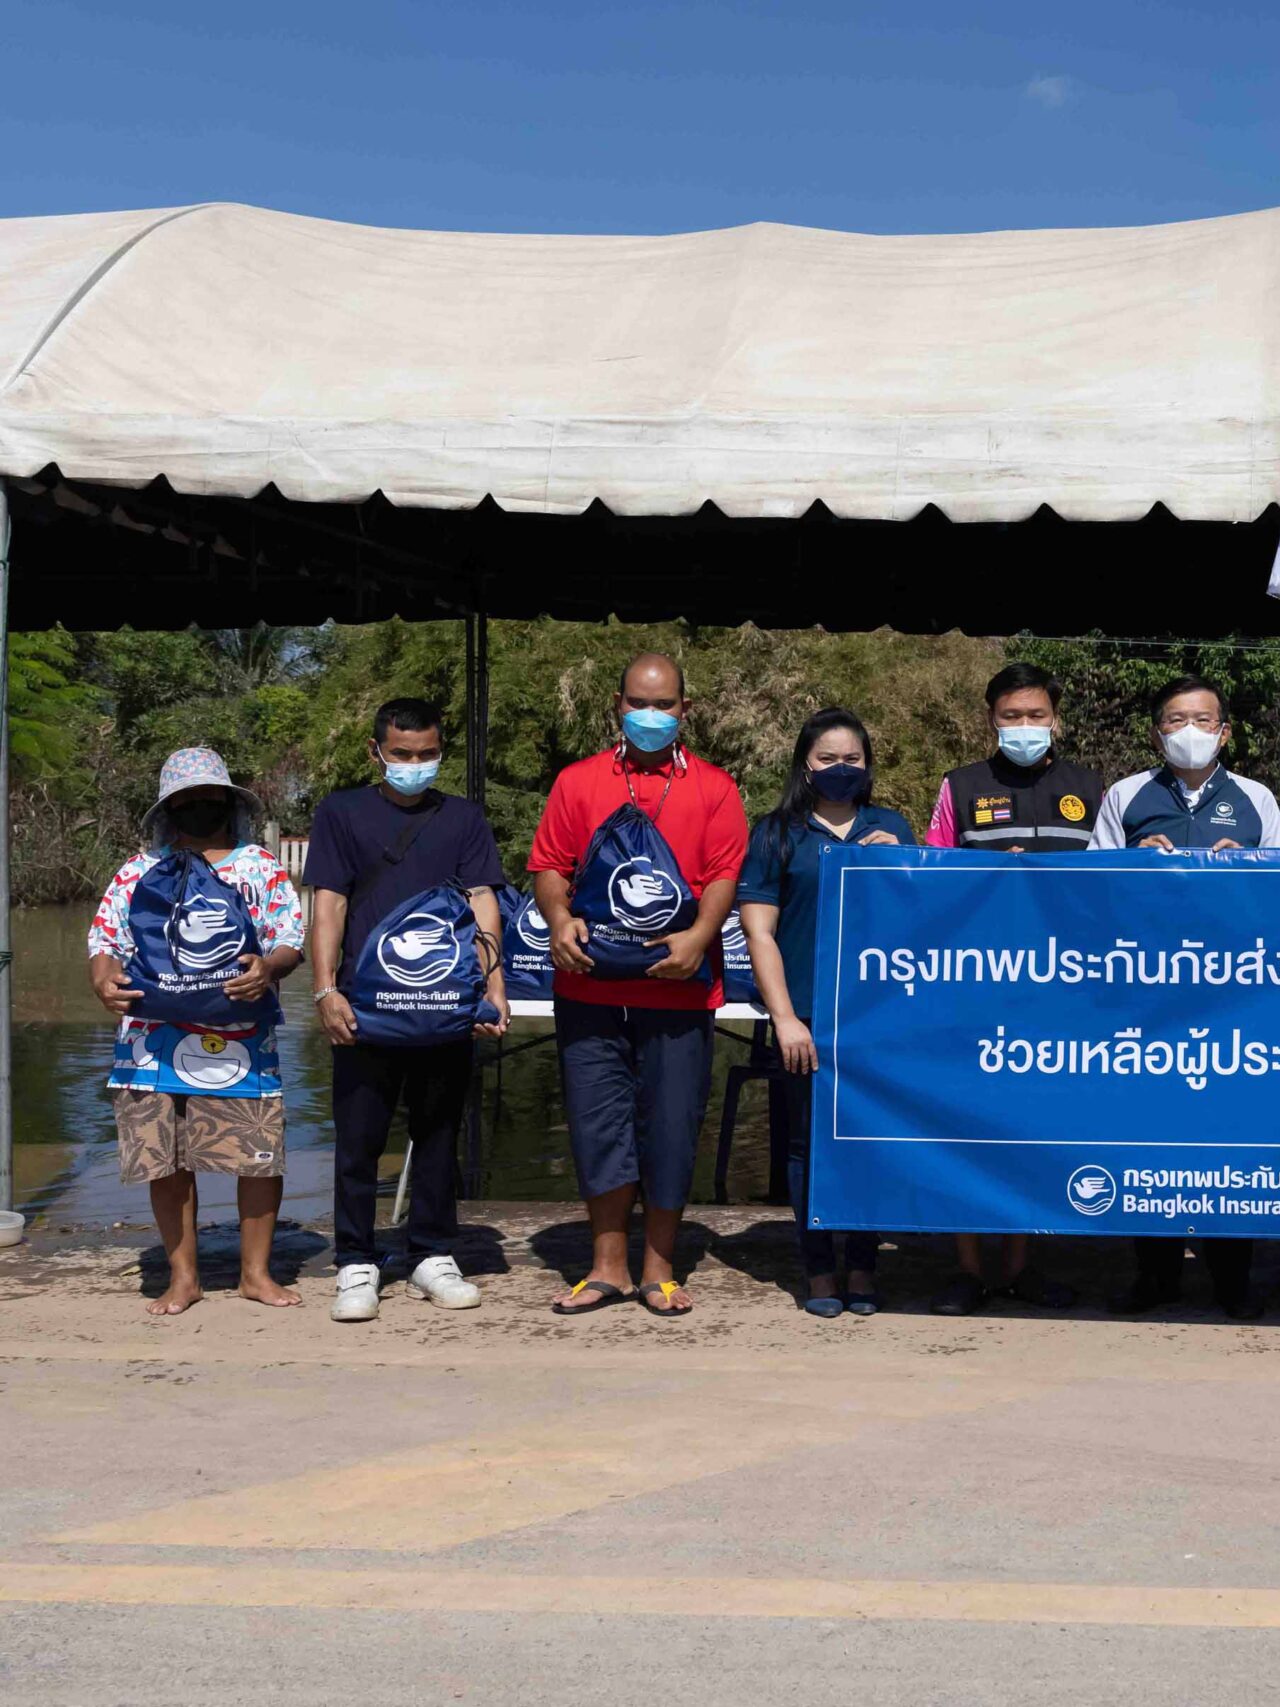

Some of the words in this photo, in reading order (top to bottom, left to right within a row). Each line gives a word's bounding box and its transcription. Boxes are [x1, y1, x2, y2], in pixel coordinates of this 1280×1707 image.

[512, 962, 541, 971] Bangkok
[376, 991, 460, 1003] กรุงเทพประกันภัย
[376, 1002, 416, 1012] Bangkok
[417, 1002, 459, 1011] Insurance
[1123, 1193, 1215, 1219] Bangkok
